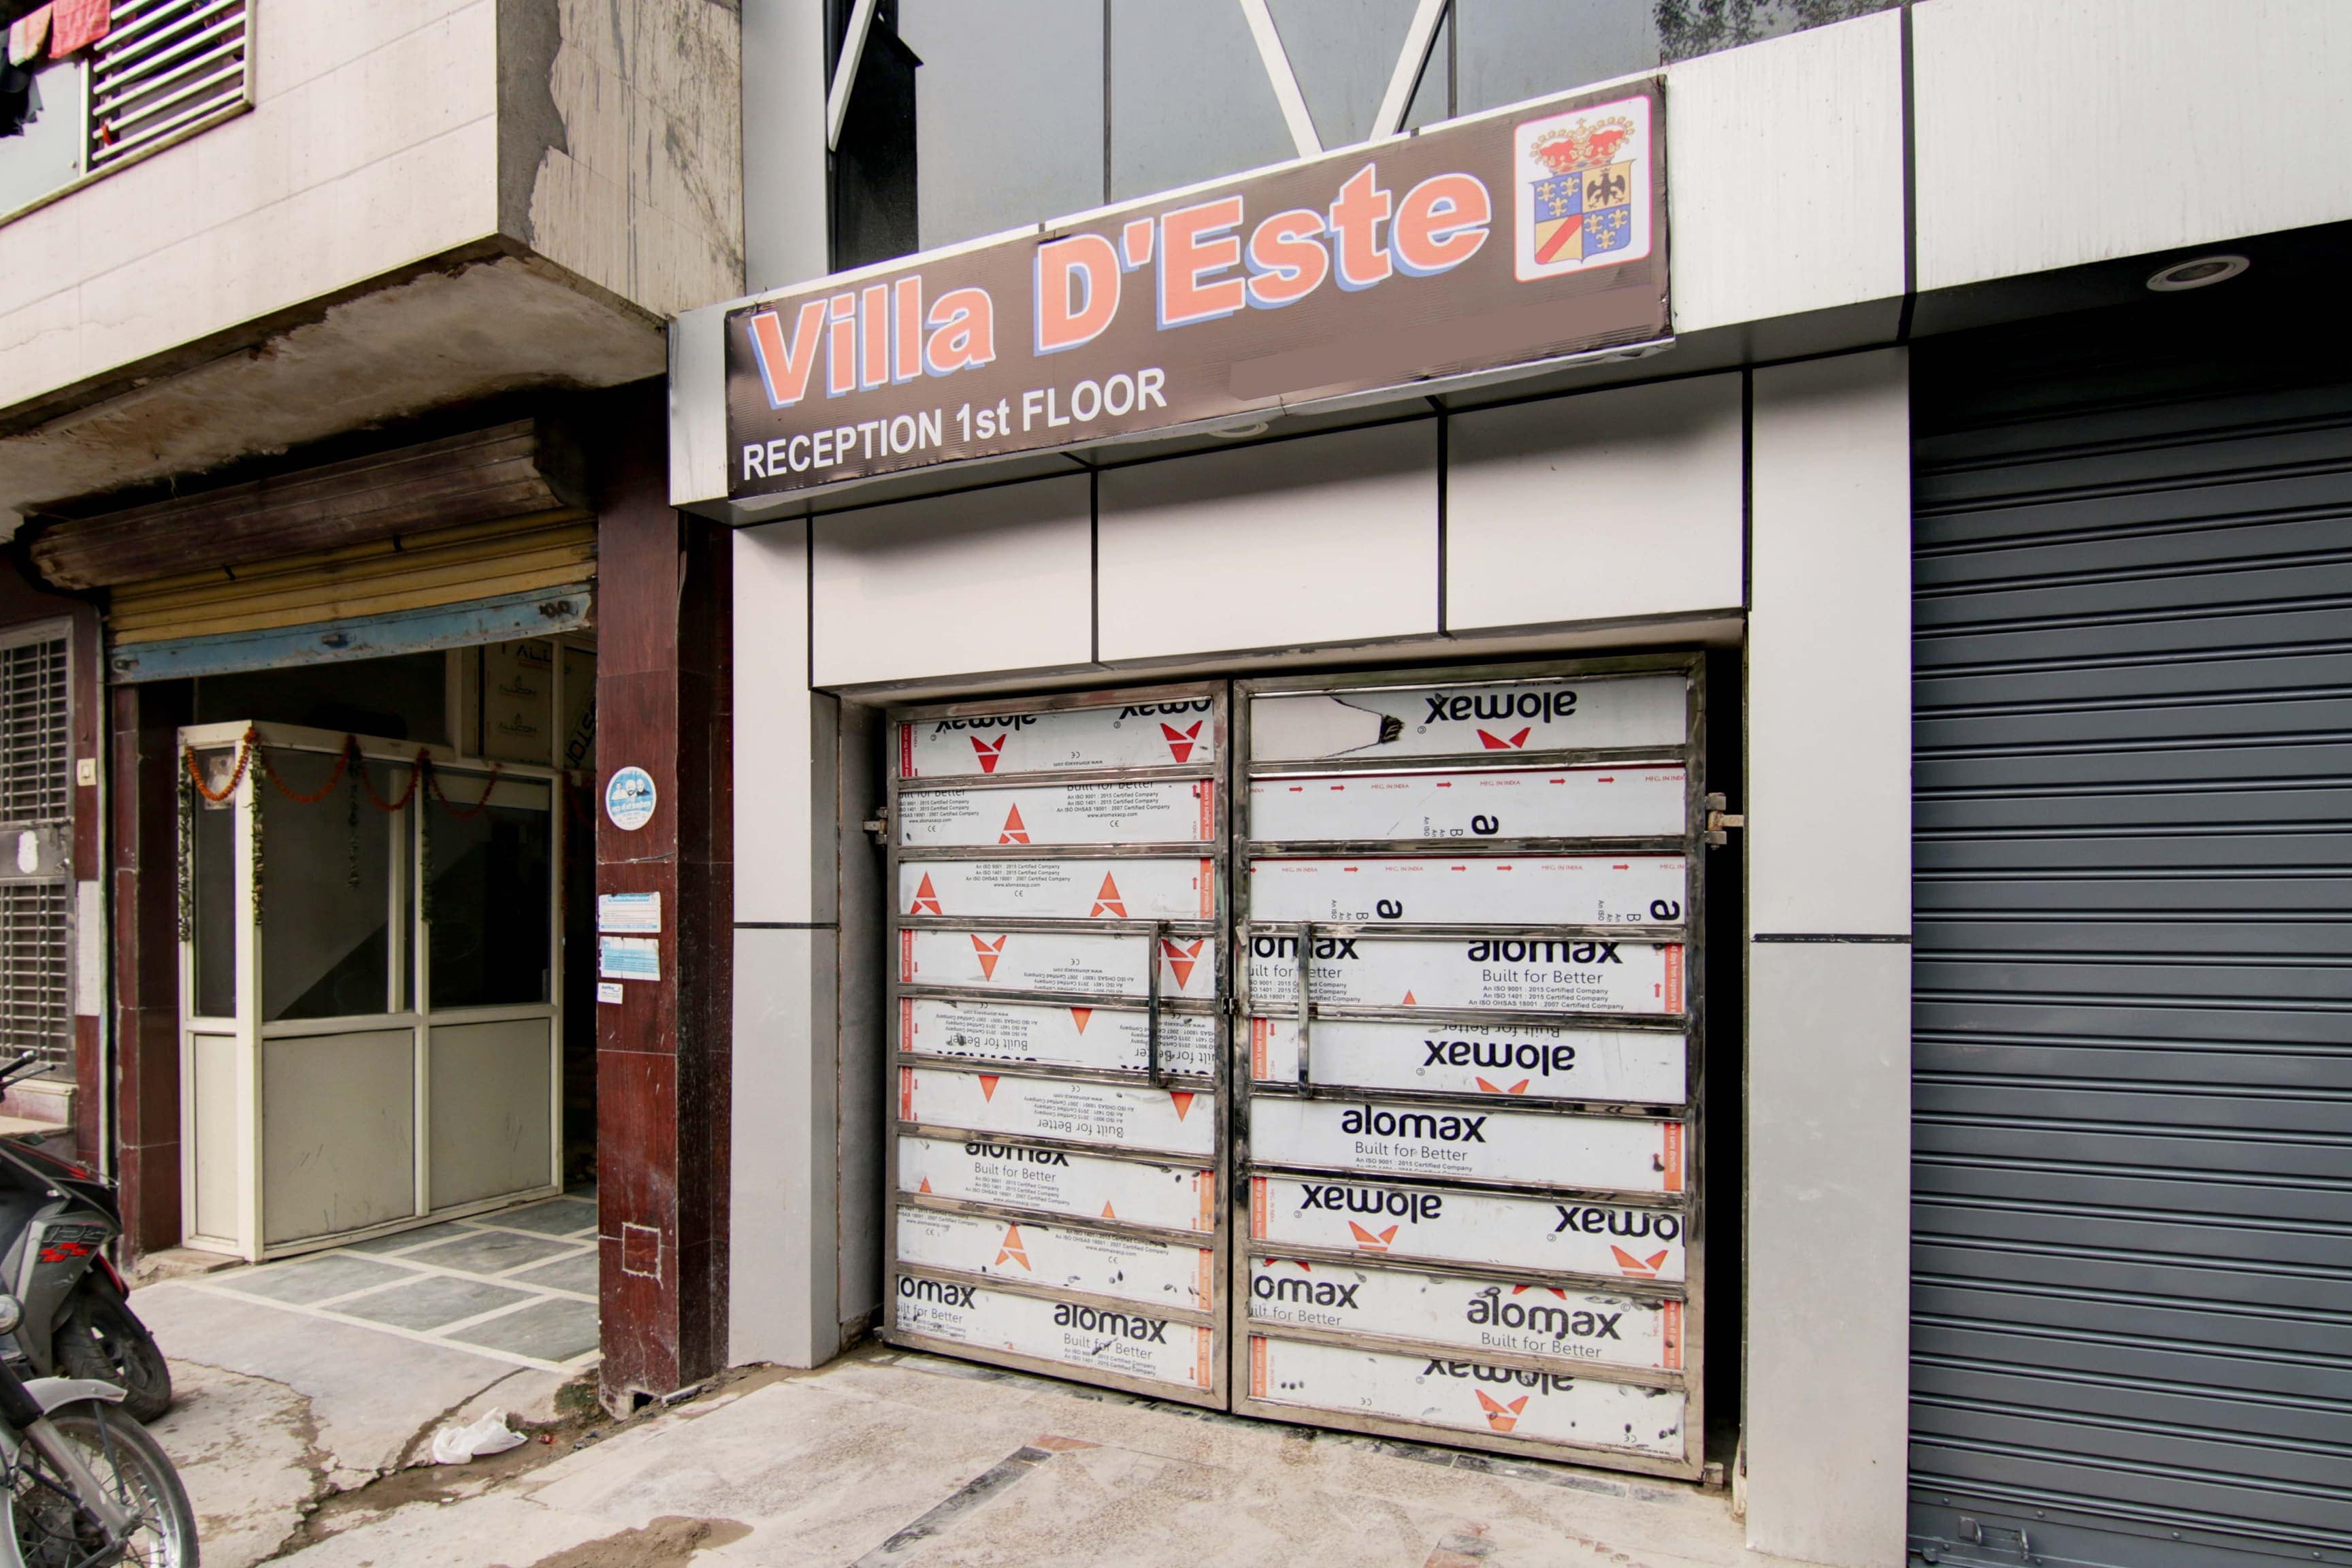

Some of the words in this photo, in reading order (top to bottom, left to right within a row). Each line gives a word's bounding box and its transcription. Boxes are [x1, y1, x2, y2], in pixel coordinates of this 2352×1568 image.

[747, 275, 996, 410] Villa
[1034, 163, 1492, 356] D'Este
[743, 408, 943, 481] RECEPTION
[956, 397, 1011, 442] 1st
[1023, 368, 1167, 431] FLOOR
[1424, 691, 1577, 724] alomax
[1274, 964, 1293, 977] for
[1309, 968, 1342, 977] etter
[1483, 969, 1518, 983] Built
[1524, 969, 1547, 983] for
[1554, 970, 1603, 984] Better
[984, 1037, 999, 1049] for
[1002, 1039, 1027, 1051] Built
[1424, 1041, 1575, 1076] alomax
[1037, 1120, 1071, 1132] Better
[1076, 1123, 1092, 1135] for
[1097, 1126, 1123, 1138] Built
[1342, 1105, 1487, 1143] alomax
[1356, 1141, 1388, 1156] Built
[1394, 1143, 1415, 1157] for
[1421, 1146, 1467, 1161] Better
[975, 1162, 998, 1175] Built
[1003, 1165, 1018, 1177] for
[1022, 1169, 1056, 1182] Better
[1301, 1184, 1442, 1224] alomax
[914, 1304, 928, 1317] for
[932, 1308, 962, 1323] Better
[1273, 1306, 1292, 1320] for
[1298, 1309, 1342, 1326] Better
[1467, 1293, 1622, 1340] alomax
[1054, 1305, 1168, 1345] alomax
[1064, 1333, 1090, 1348] Built
[1116, 1343, 1153, 1359] Better
[1482, 1332, 1517, 1348] Built
[1523, 1336, 1546, 1352] for
[1552, 1340, 1601, 1358] Better
